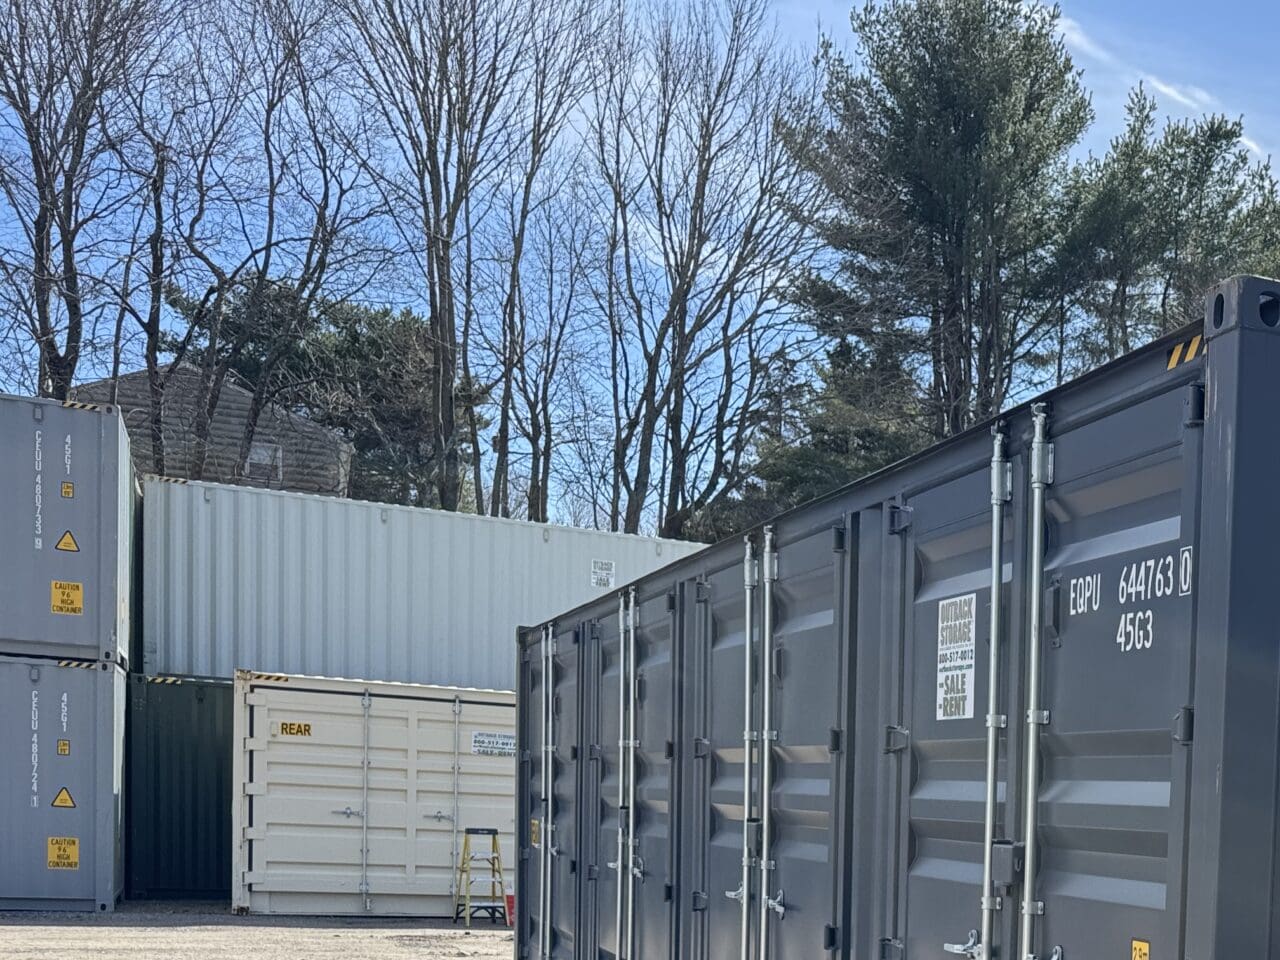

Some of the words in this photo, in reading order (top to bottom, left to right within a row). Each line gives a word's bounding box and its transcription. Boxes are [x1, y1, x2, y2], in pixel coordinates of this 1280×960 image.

[54, 582, 80, 592] CAUTION
[1069, 573, 1101, 616] EQPU
[1118, 555, 1174, 604] 644763
[60, 598, 75, 606] HIGH
[52, 605, 82, 614] CONTAINER
[941, 597, 974, 624] OUTBACK
[940, 620, 972, 646] STORAGE
[1116, 609, 1153, 652] 45G3
[281, 722, 312, 737] REAR
[50, 838, 76, 847] CAUTION
[56, 853, 71, 861] HIGH
[48, 860, 78, 869] CONTAINER
